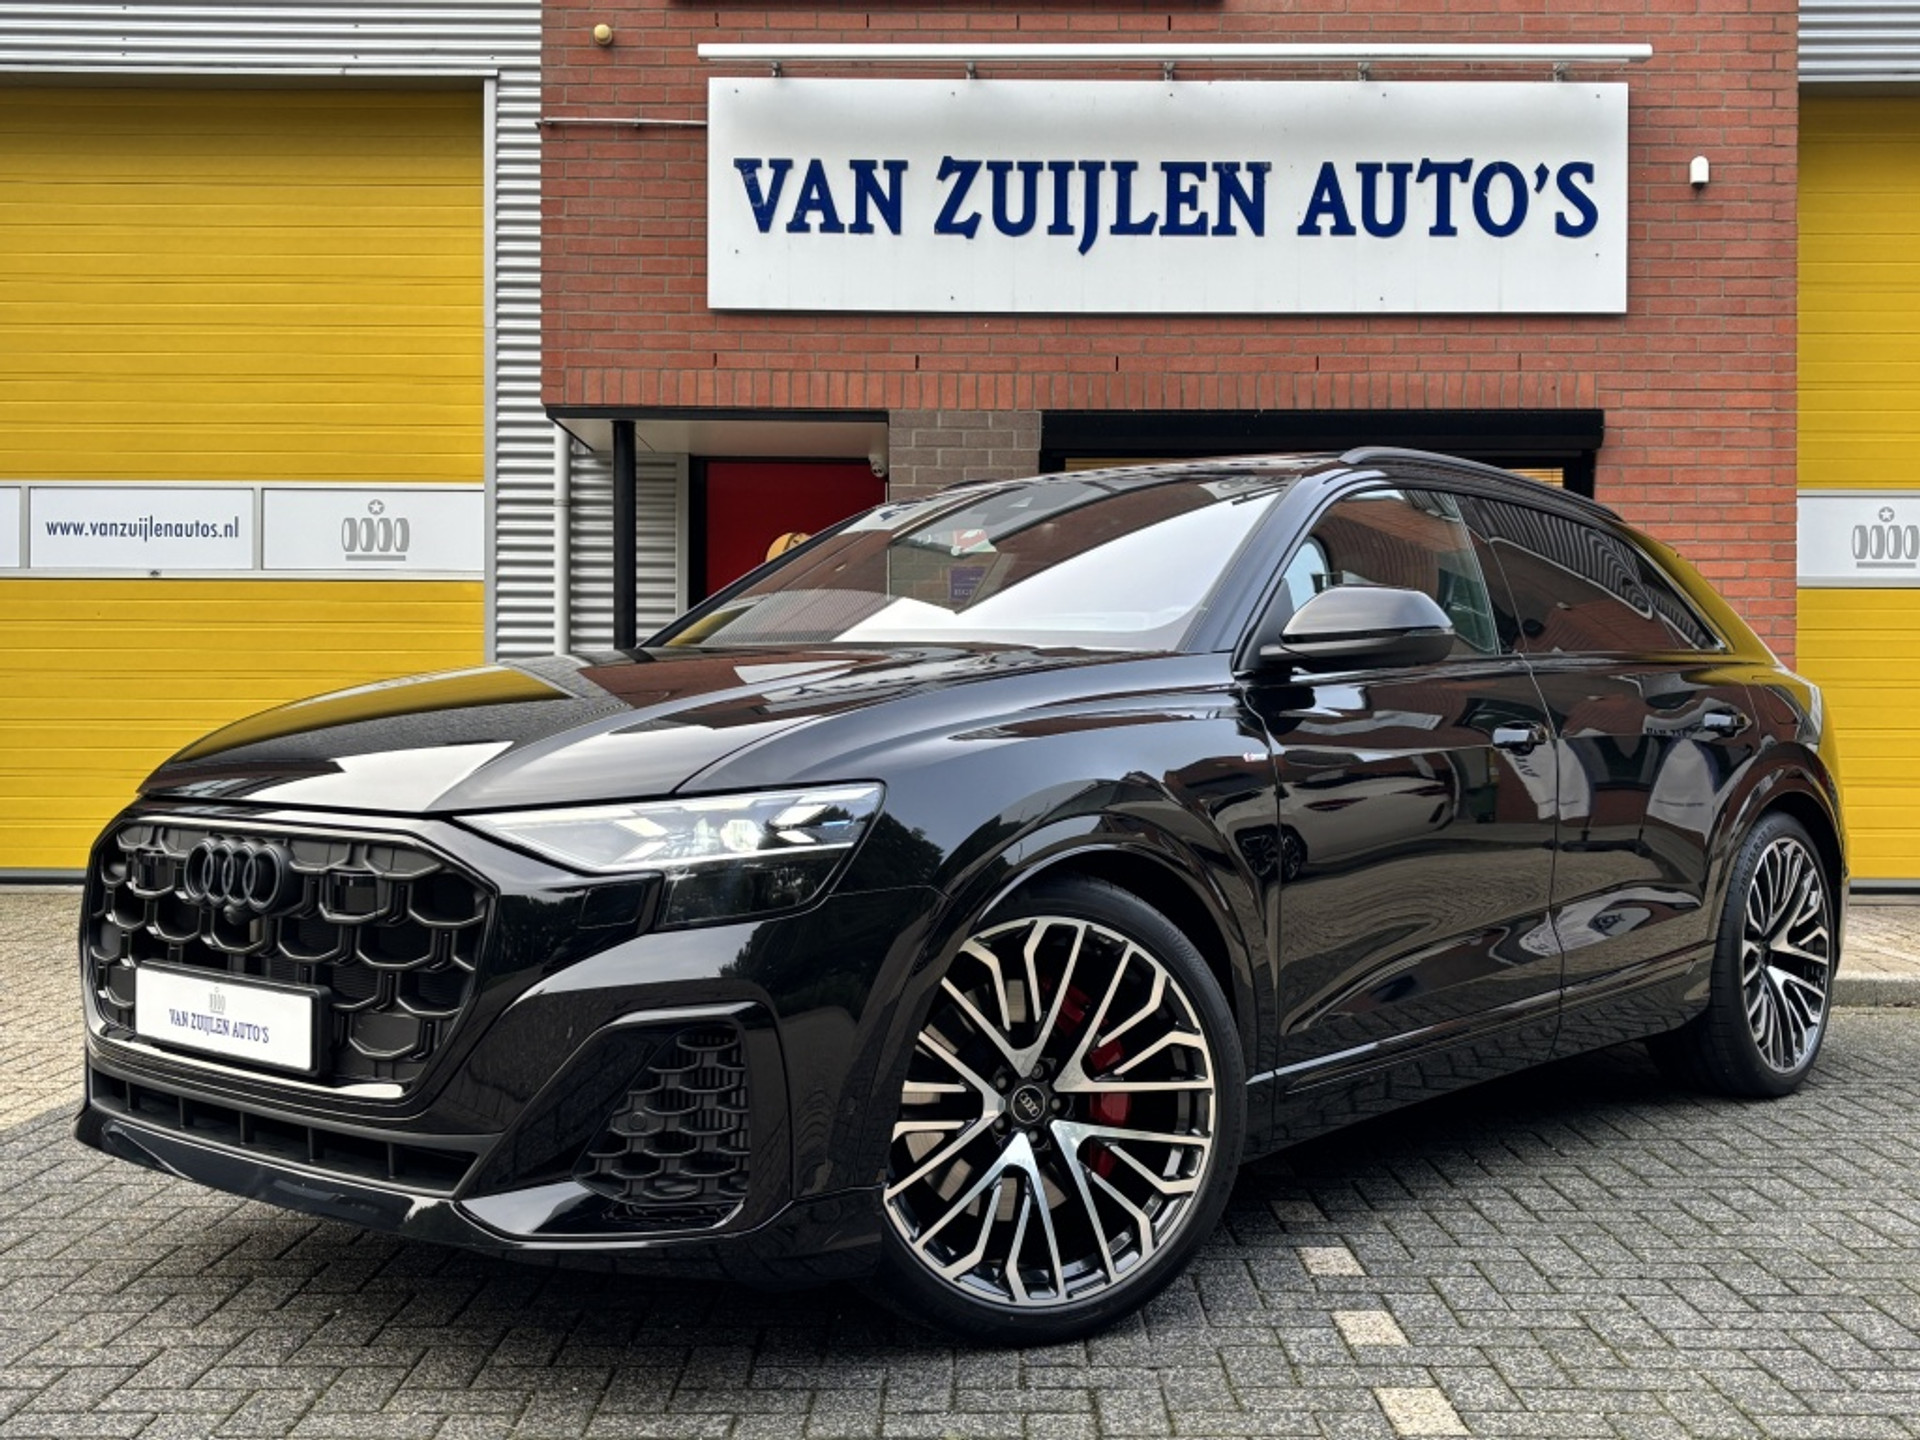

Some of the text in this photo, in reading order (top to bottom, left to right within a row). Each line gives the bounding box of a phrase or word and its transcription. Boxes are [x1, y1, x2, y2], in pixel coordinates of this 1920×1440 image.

[733, 155, 1599, 256] VAN ZUIJLEN AUTO'S
[46, 514, 239, 543] www.vanzuijlenautos.nl
[168, 1008, 270, 1044] VAN ZUIJLEN AUTO'S
